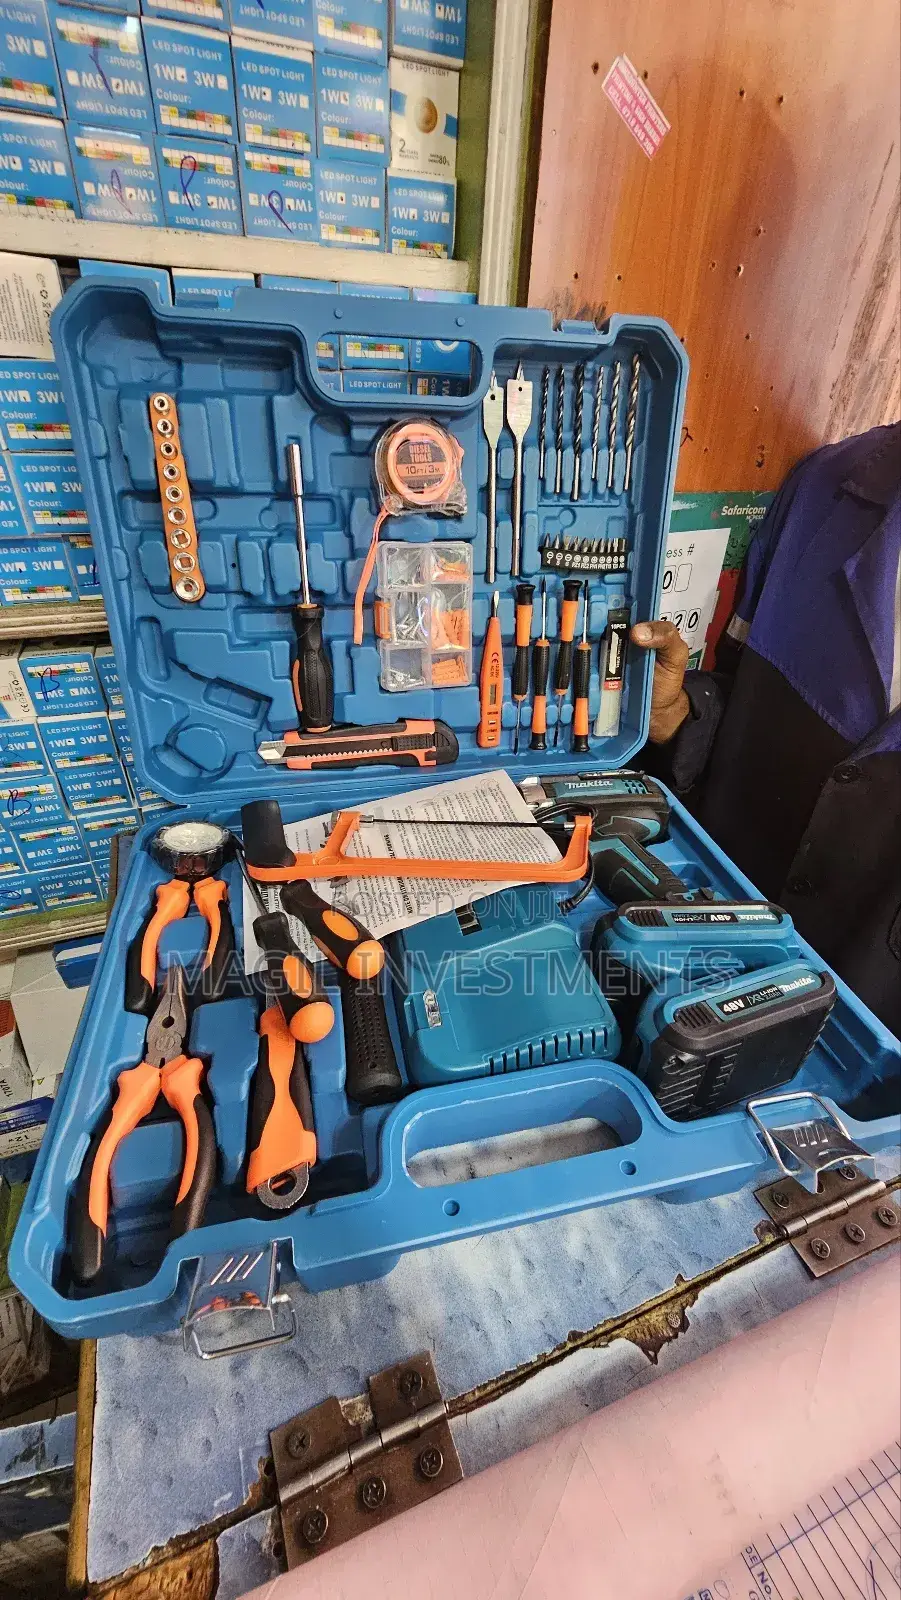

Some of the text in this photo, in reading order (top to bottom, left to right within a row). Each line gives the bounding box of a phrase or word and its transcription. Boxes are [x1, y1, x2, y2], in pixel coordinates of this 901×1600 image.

[152, 39, 223, 61] LED SPOT LIGHT
[153, 63, 215, 88] 1W 3W
[241, 62, 305, 82] LED SPOT LIGHT
[322, 67, 337, 79] LED
[339, 70, 358, 81] SPOT
[123, 81, 146, 97] 1W
[155, 88, 191, 103] Colour:
[241, 84, 298, 107] 1W 3W
[321, 88, 340, 104] 1W
[242, 108, 275, 122] Colour:
[28, 158, 52, 175] 3W
[320, 171, 378, 185] LED SPOT LIGHT
[0, 179, 29, 191] olour:
[136, 188, 156, 202] 1W
[319, 190, 370, 208] 1W 3W
[216, 196, 237, 211] 1W
[293, 199, 313, 212] 1W
[319, 210, 348, 222] Colour:
[392, 206, 440, 223] 1W 3W
[391, 225, 418, 237] Colour:
[0, 371, 36, 379] ED SPOT
[36, 390, 59, 403] 3W
[1, 410, 37, 420] Colour:
[409, 445, 431, 453] DIESEL
[410, 453, 432, 462] TOOLS
[21, 465, 38, 473] LED
[24, 482, 46, 492] 1W
[721, 504, 766, 516] Safaricom
[32, 561, 52, 571] 3W
[80, 686, 96, 695] 1W
[49, 736, 97, 748] 1W 3W
[67, 784, 83, 792] 1W
[40, 884, 56, 892] 1W
[711, 914, 731, 922] 48V
[723, 999, 745, 1013] 48V
